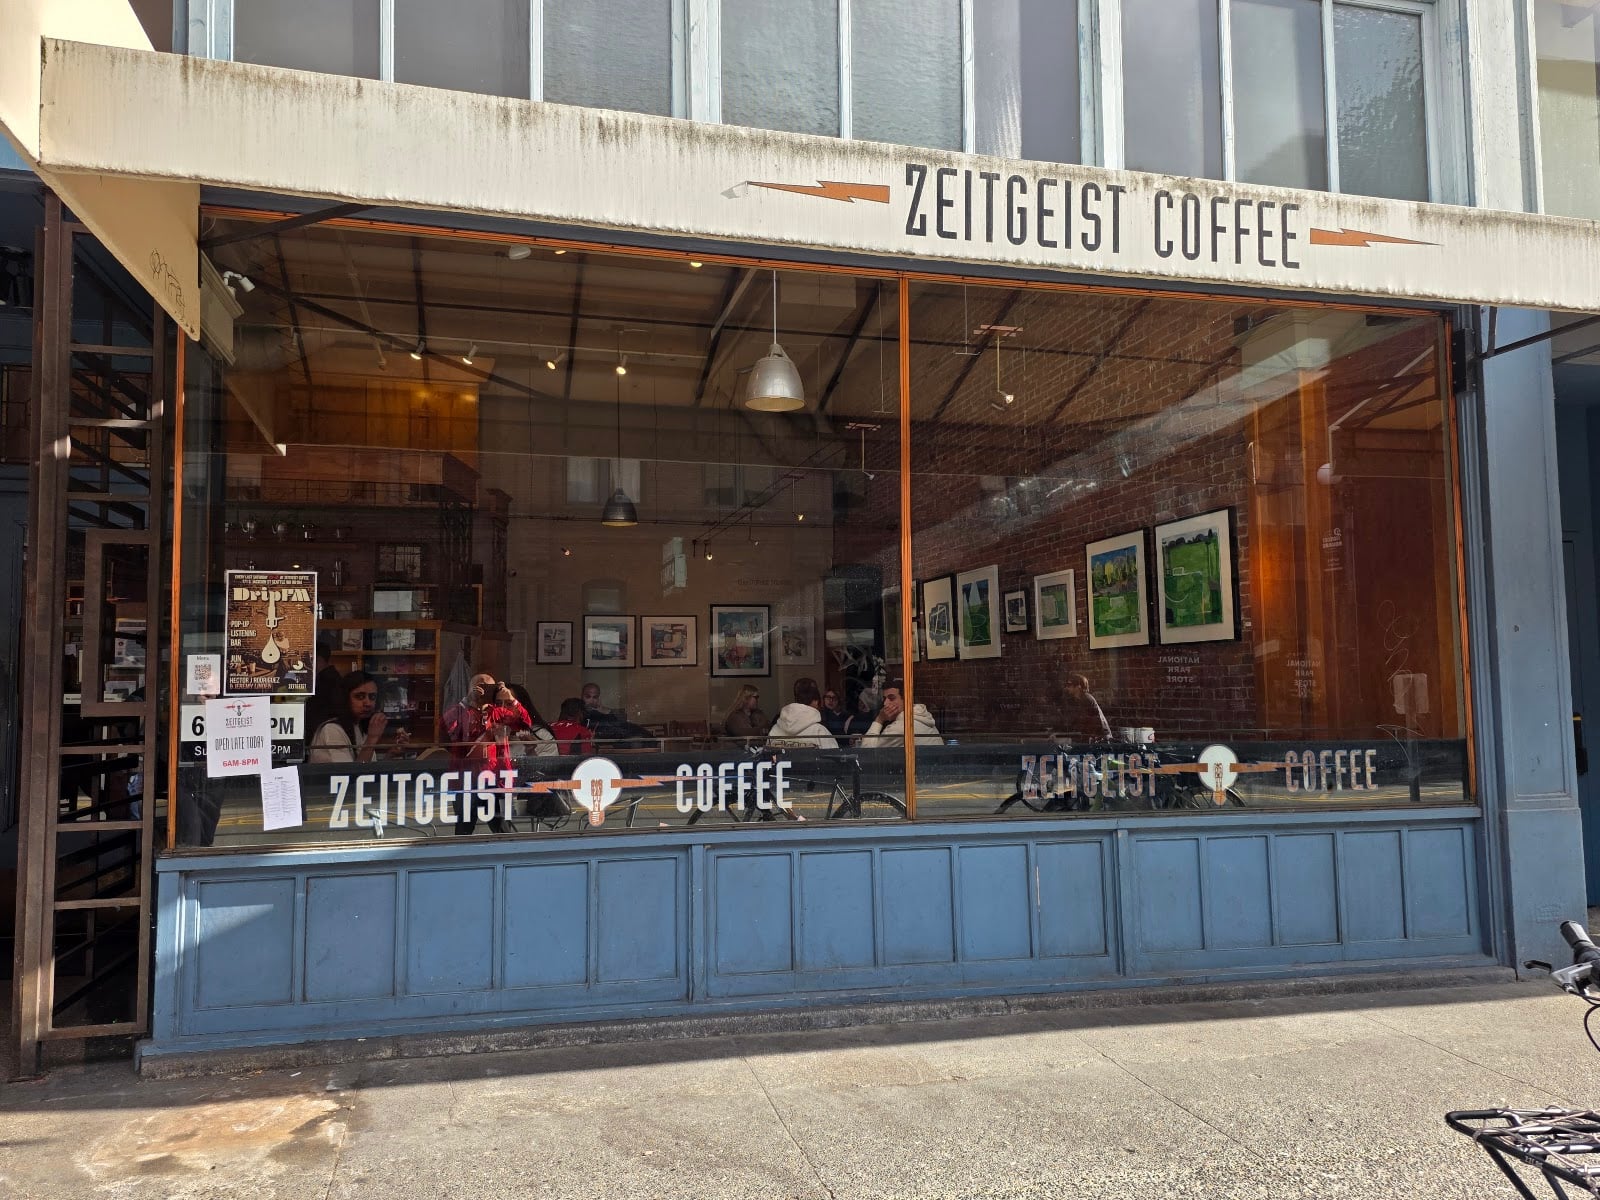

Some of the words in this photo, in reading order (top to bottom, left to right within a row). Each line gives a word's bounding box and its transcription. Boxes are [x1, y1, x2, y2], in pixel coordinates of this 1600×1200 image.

[905, 163, 1127, 254] ZEITGEIST
[1154, 189, 1300, 270] COFFEE
[233, 587, 311, 602] DripFM
[230, 620, 250, 628] POP-UP
[230, 629, 257, 637] LISTENING
[230, 639, 242, 647] BAR
[225, 717, 253, 726] ZEITGEIST
[215, 737, 230, 750] OPEN
[231, 737, 245, 750] LATE
[246, 735, 264, 749] TODAY
[222, 758, 259, 767] 6AM-8PM
[1021, 753, 1160, 800] ZEITGEIST
[1285, 749, 1379, 792] COFFEE
[329, 769, 518, 829] ZEITGEIST
[675, 761, 793, 814] COFFEE
